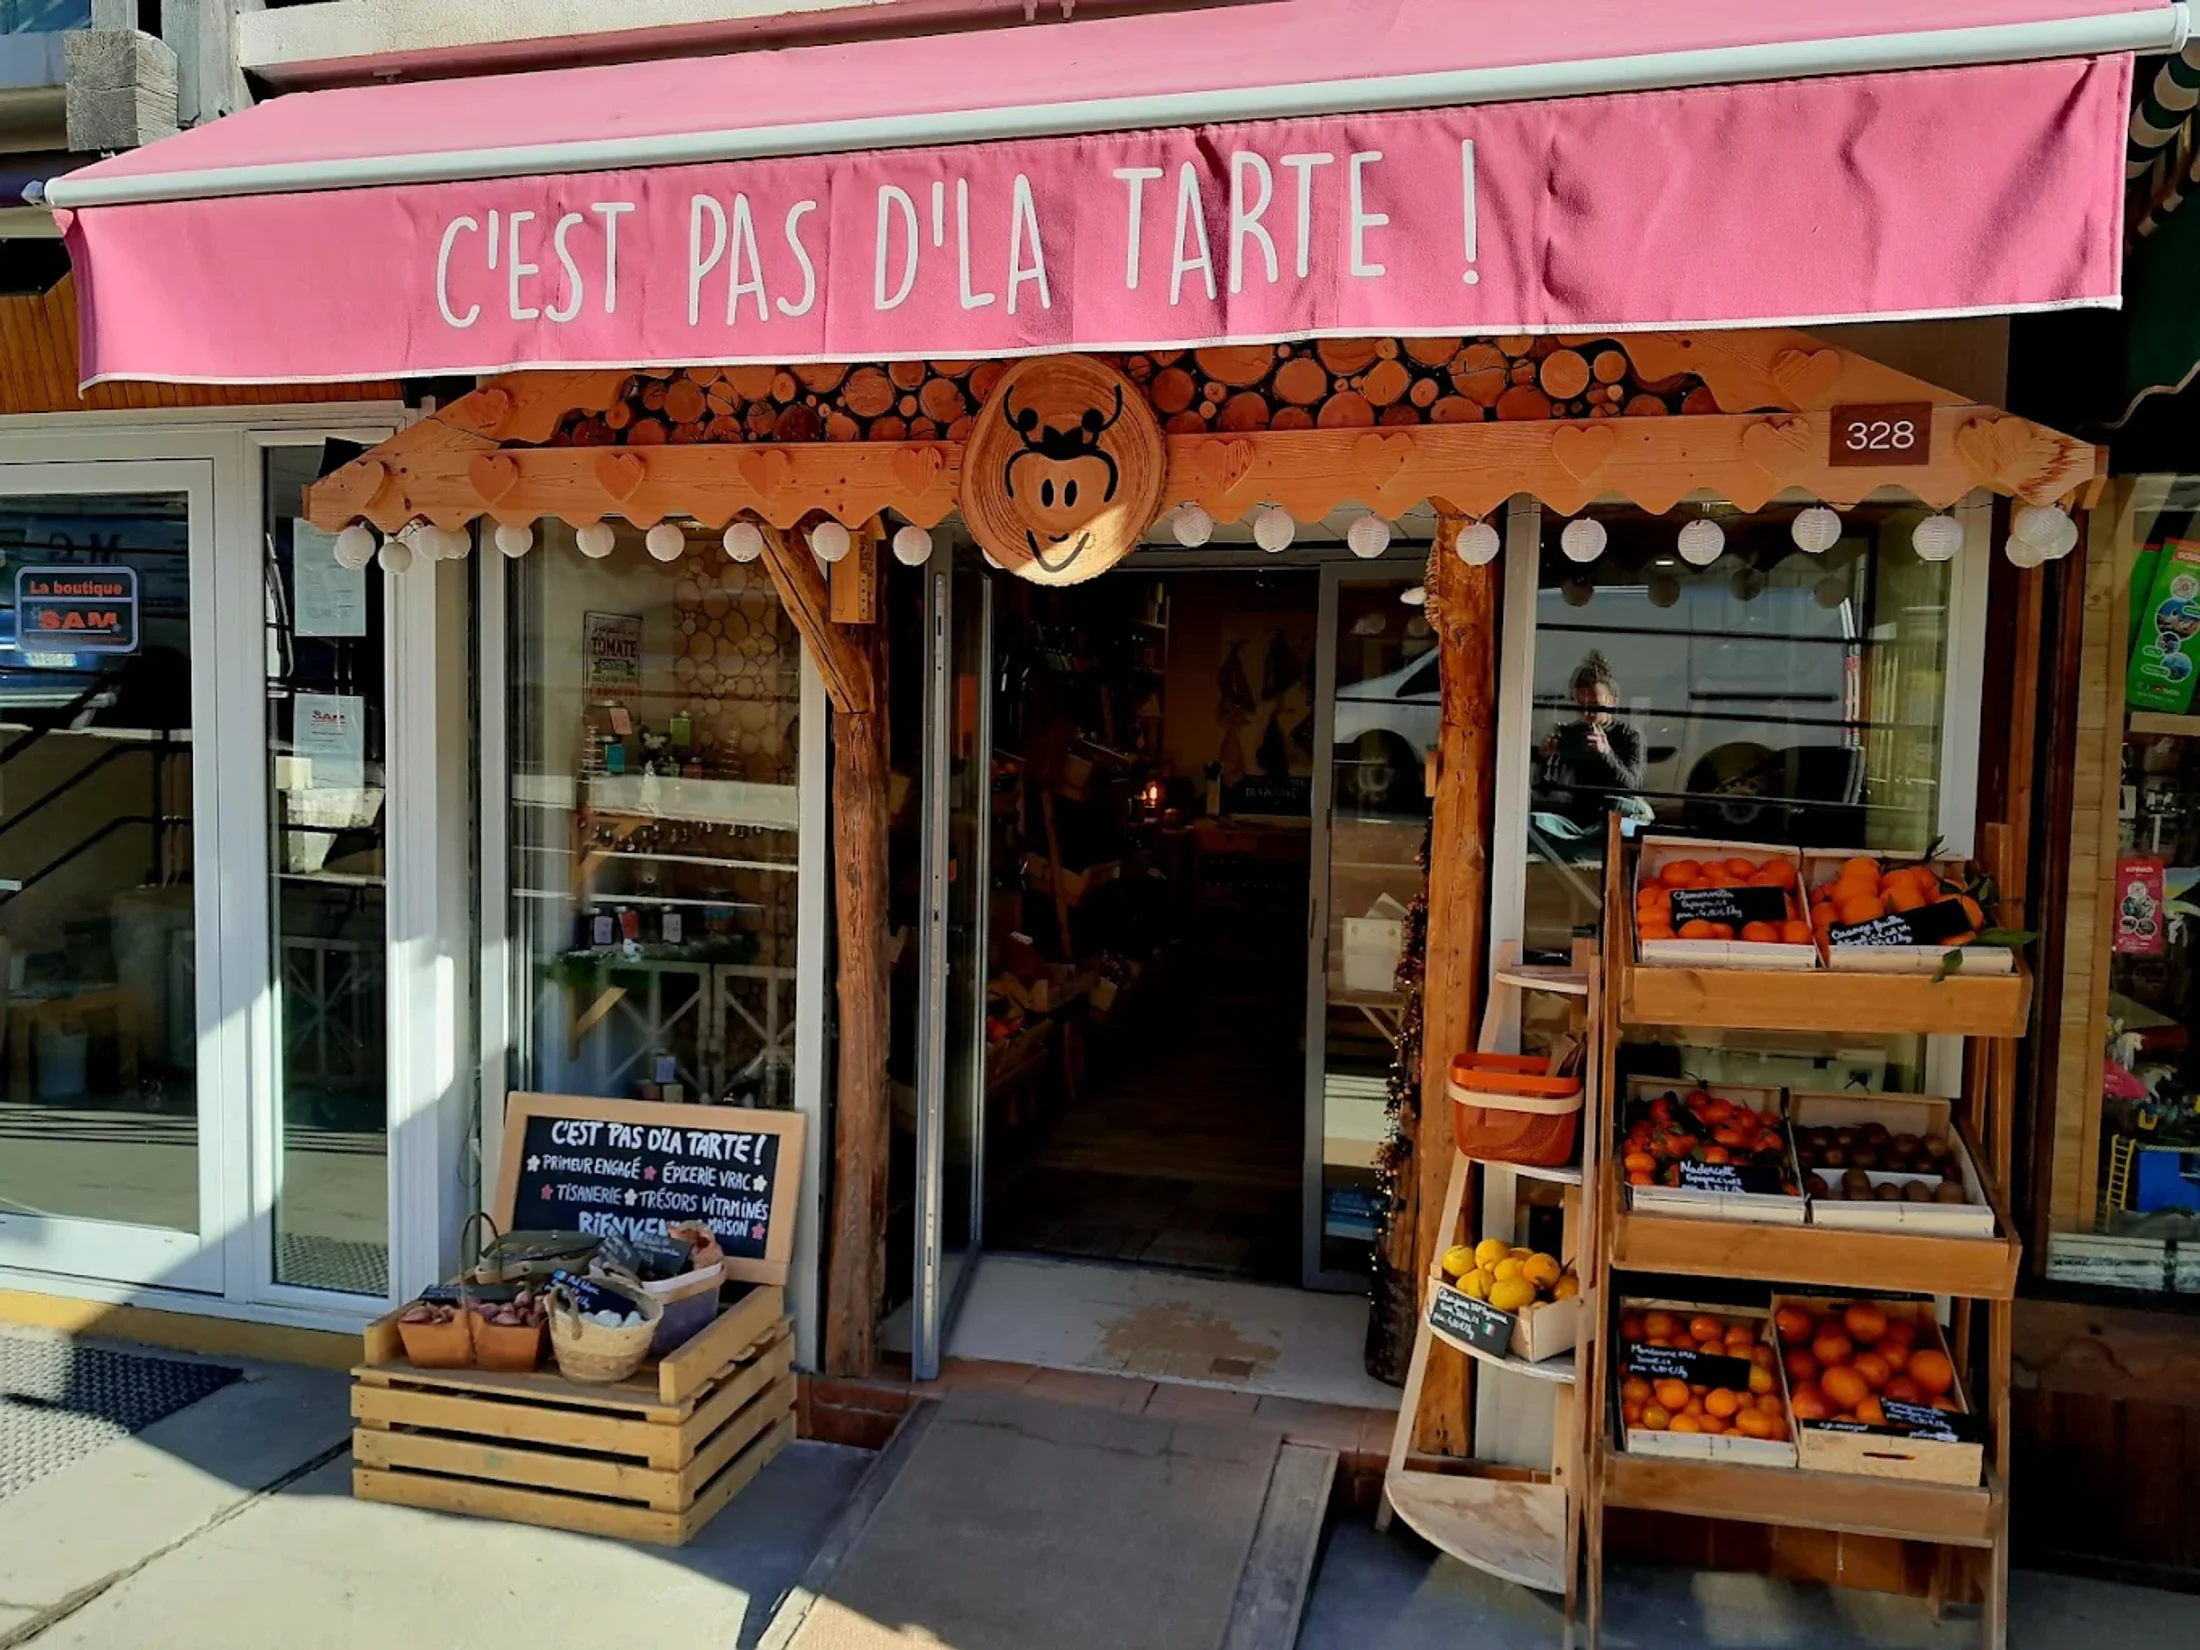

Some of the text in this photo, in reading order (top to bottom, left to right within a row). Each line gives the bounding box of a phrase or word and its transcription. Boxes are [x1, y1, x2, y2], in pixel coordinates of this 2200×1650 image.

[436, 139, 1479, 328] C'EST PAS D'LA TARTE !
[1845, 420, 1915, 450] 328
[29, 580, 123, 597] La boutique
[38, 609, 118, 630] SAM
[591, 637, 637, 657] TOMATE
[551, 1120, 604, 1147] C'EST
[608, 1123, 645, 1150] PAS
[648, 1128, 682, 1155] D'LA
[686, 1132, 752, 1163] TARTE
[594, 1156, 642, 1180] ENGAGÉ
[720, 1171, 752, 1192] VRAC
[639, 1187, 698, 1212] TRÉSORS
